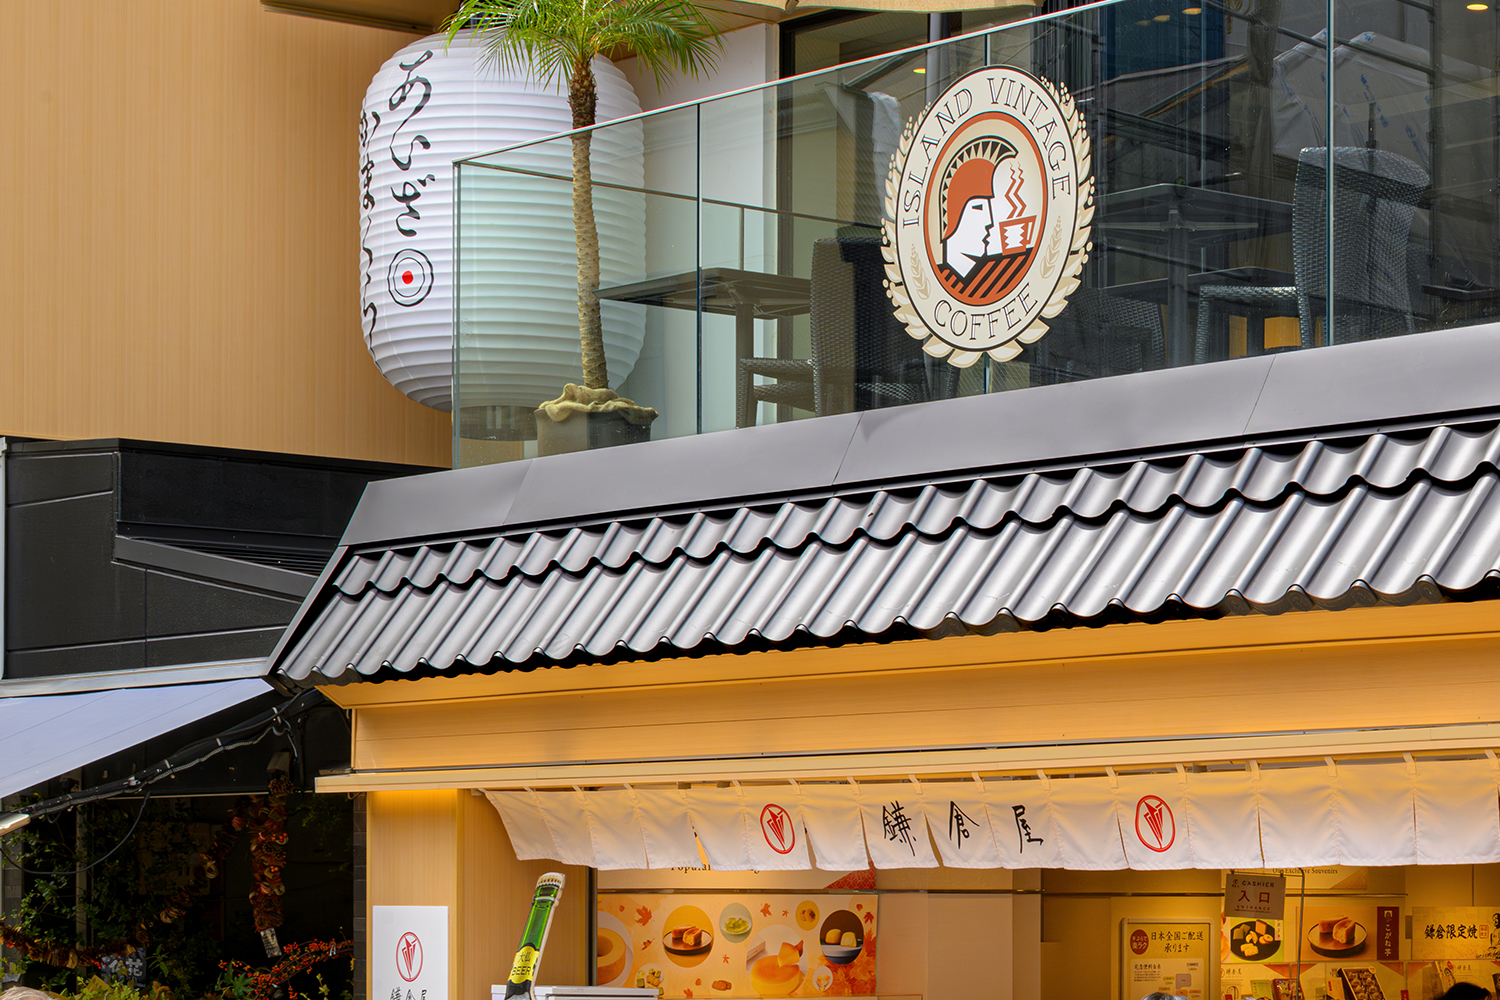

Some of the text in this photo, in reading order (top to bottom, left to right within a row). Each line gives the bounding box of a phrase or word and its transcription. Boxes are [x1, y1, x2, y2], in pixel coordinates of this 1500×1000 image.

[902, 76, 1072, 230] ISLAND VINTAGE
[933, 281, 1039, 341] COFFEE
[882, 799, 1045, 858] 鎌倉屋
[1311, 866, 1339, 875] Souvenirs
[1241, 879, 1275, 888] CASHIER
[1238, 890, 1271, 904] 入口
[1150, 930, 1204, 942] 日本全国ご配送
[1424, 923, 1479, 940] 鎌倉限定焼
[1163, 943, 1190, 953] 承ります
[511, 966, 532, 976] BEER
